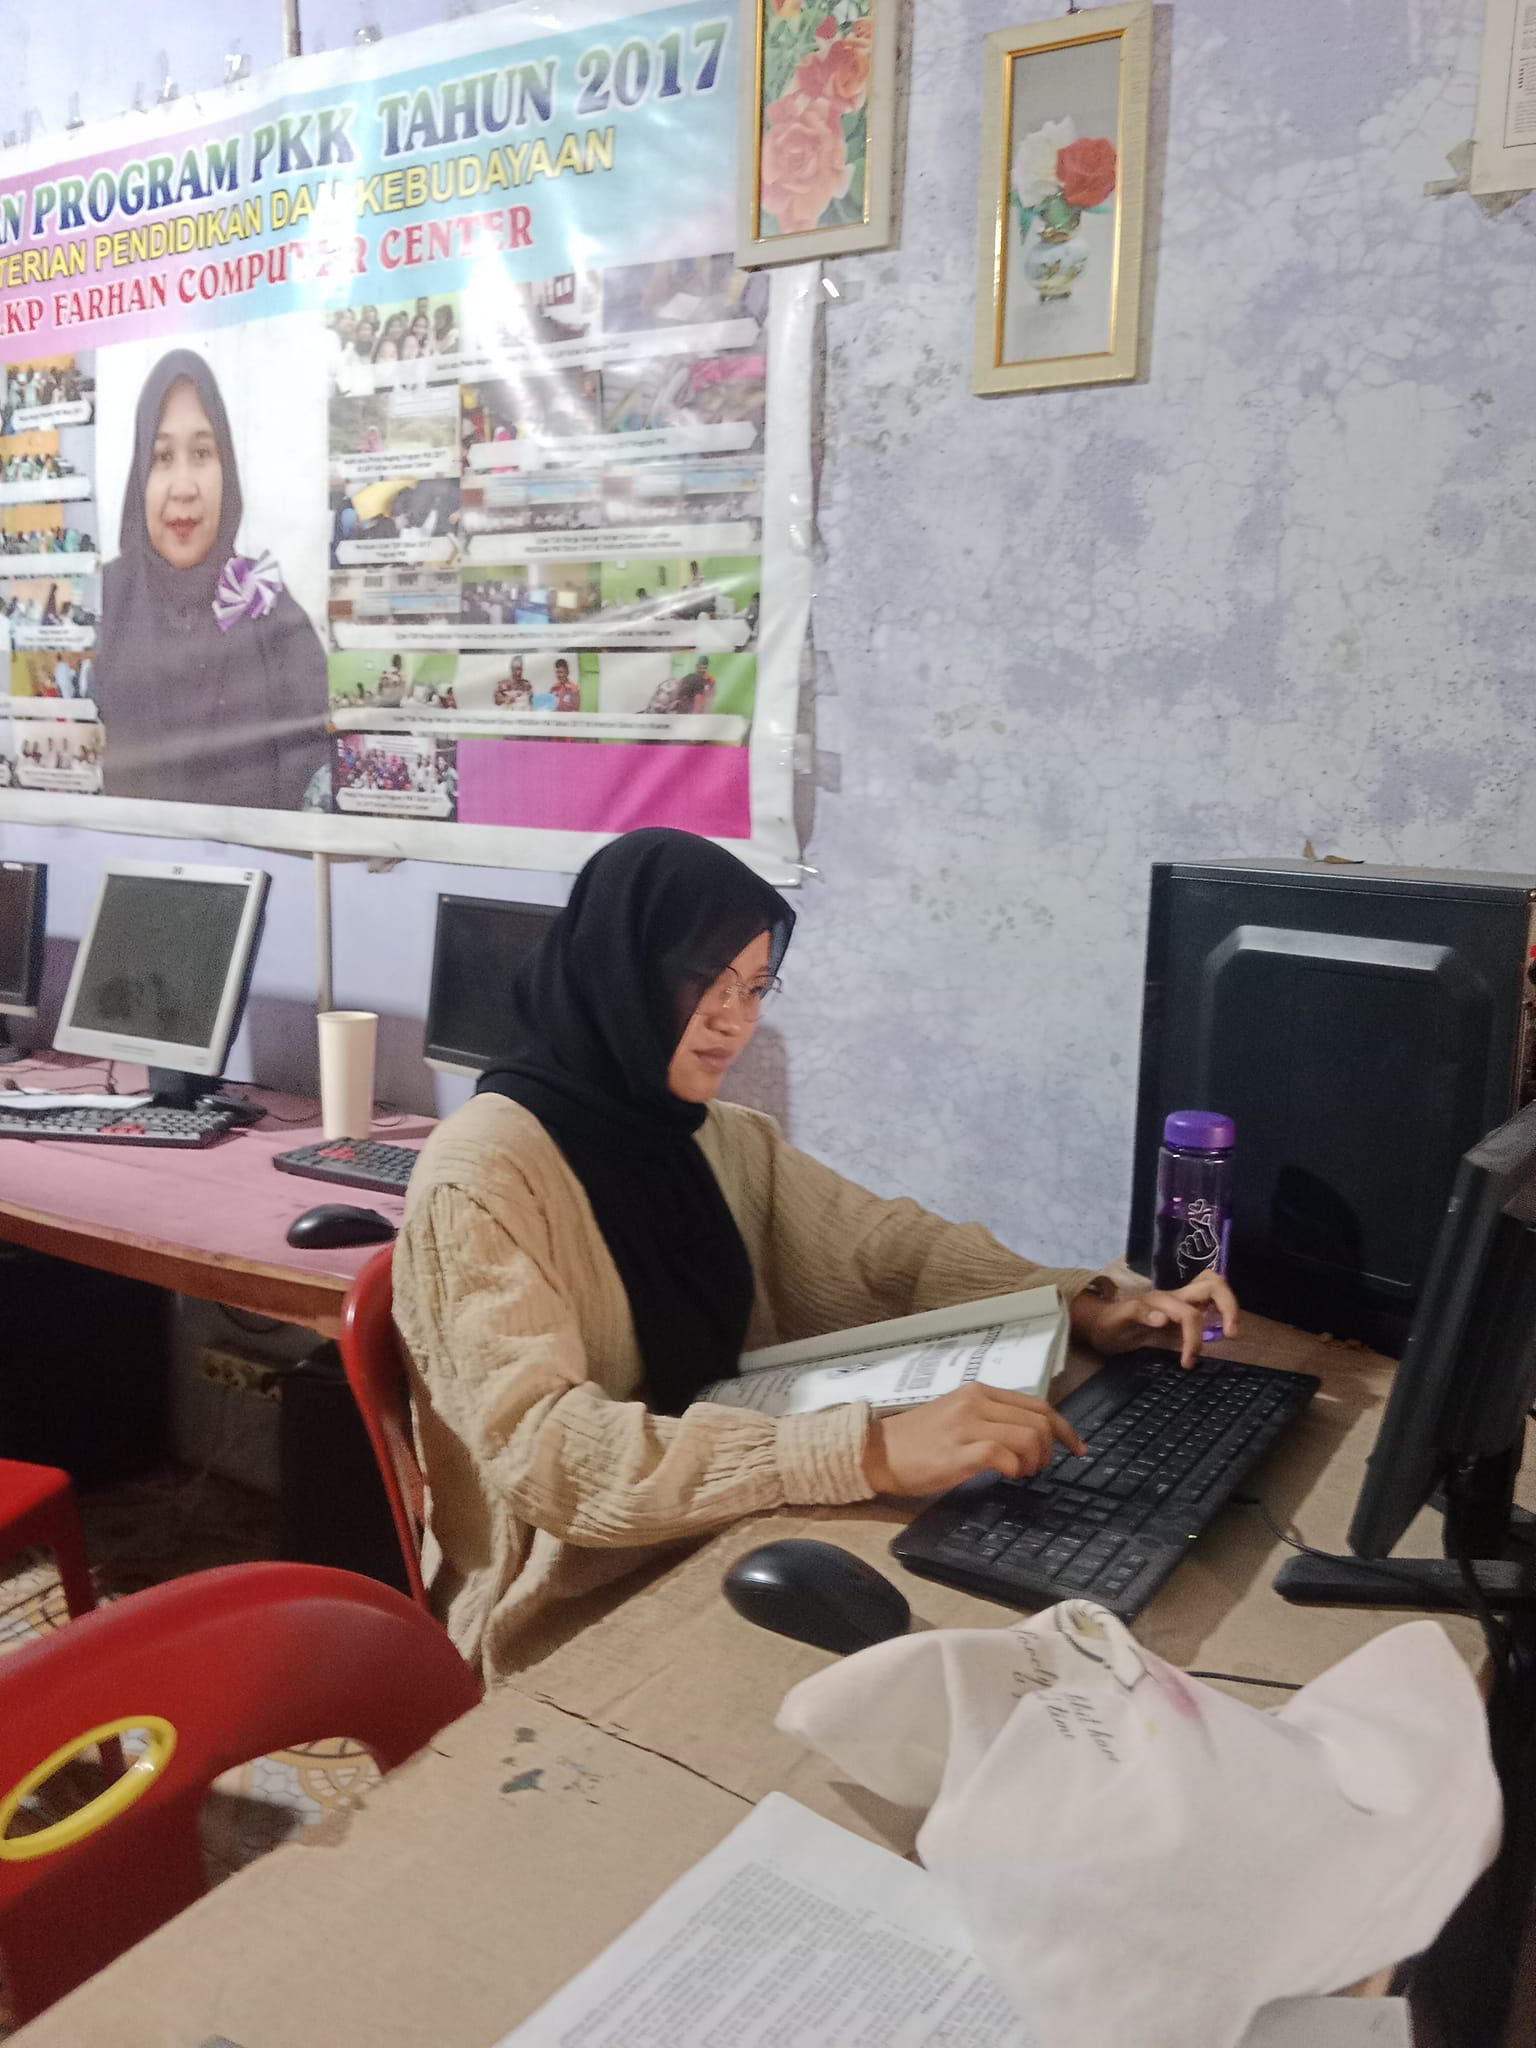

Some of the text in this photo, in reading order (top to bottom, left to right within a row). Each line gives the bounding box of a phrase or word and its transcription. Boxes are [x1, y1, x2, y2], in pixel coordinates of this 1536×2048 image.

[33, 138, 240, 235] PROGRAM
[252, 107, 354, 183] PKK
[378, 60, 556, 156] TAHUN
[577, 21, 728, 115] 2017
[94, 194, 262, 272] PENDIDIKAN
[357, 126, 616, 217] KEBUDAYAAN
[0, 299, 44, 335] KP
[55, 272, 168, 326] FARHAN
[178, 236, 367, 304] COMPUR
